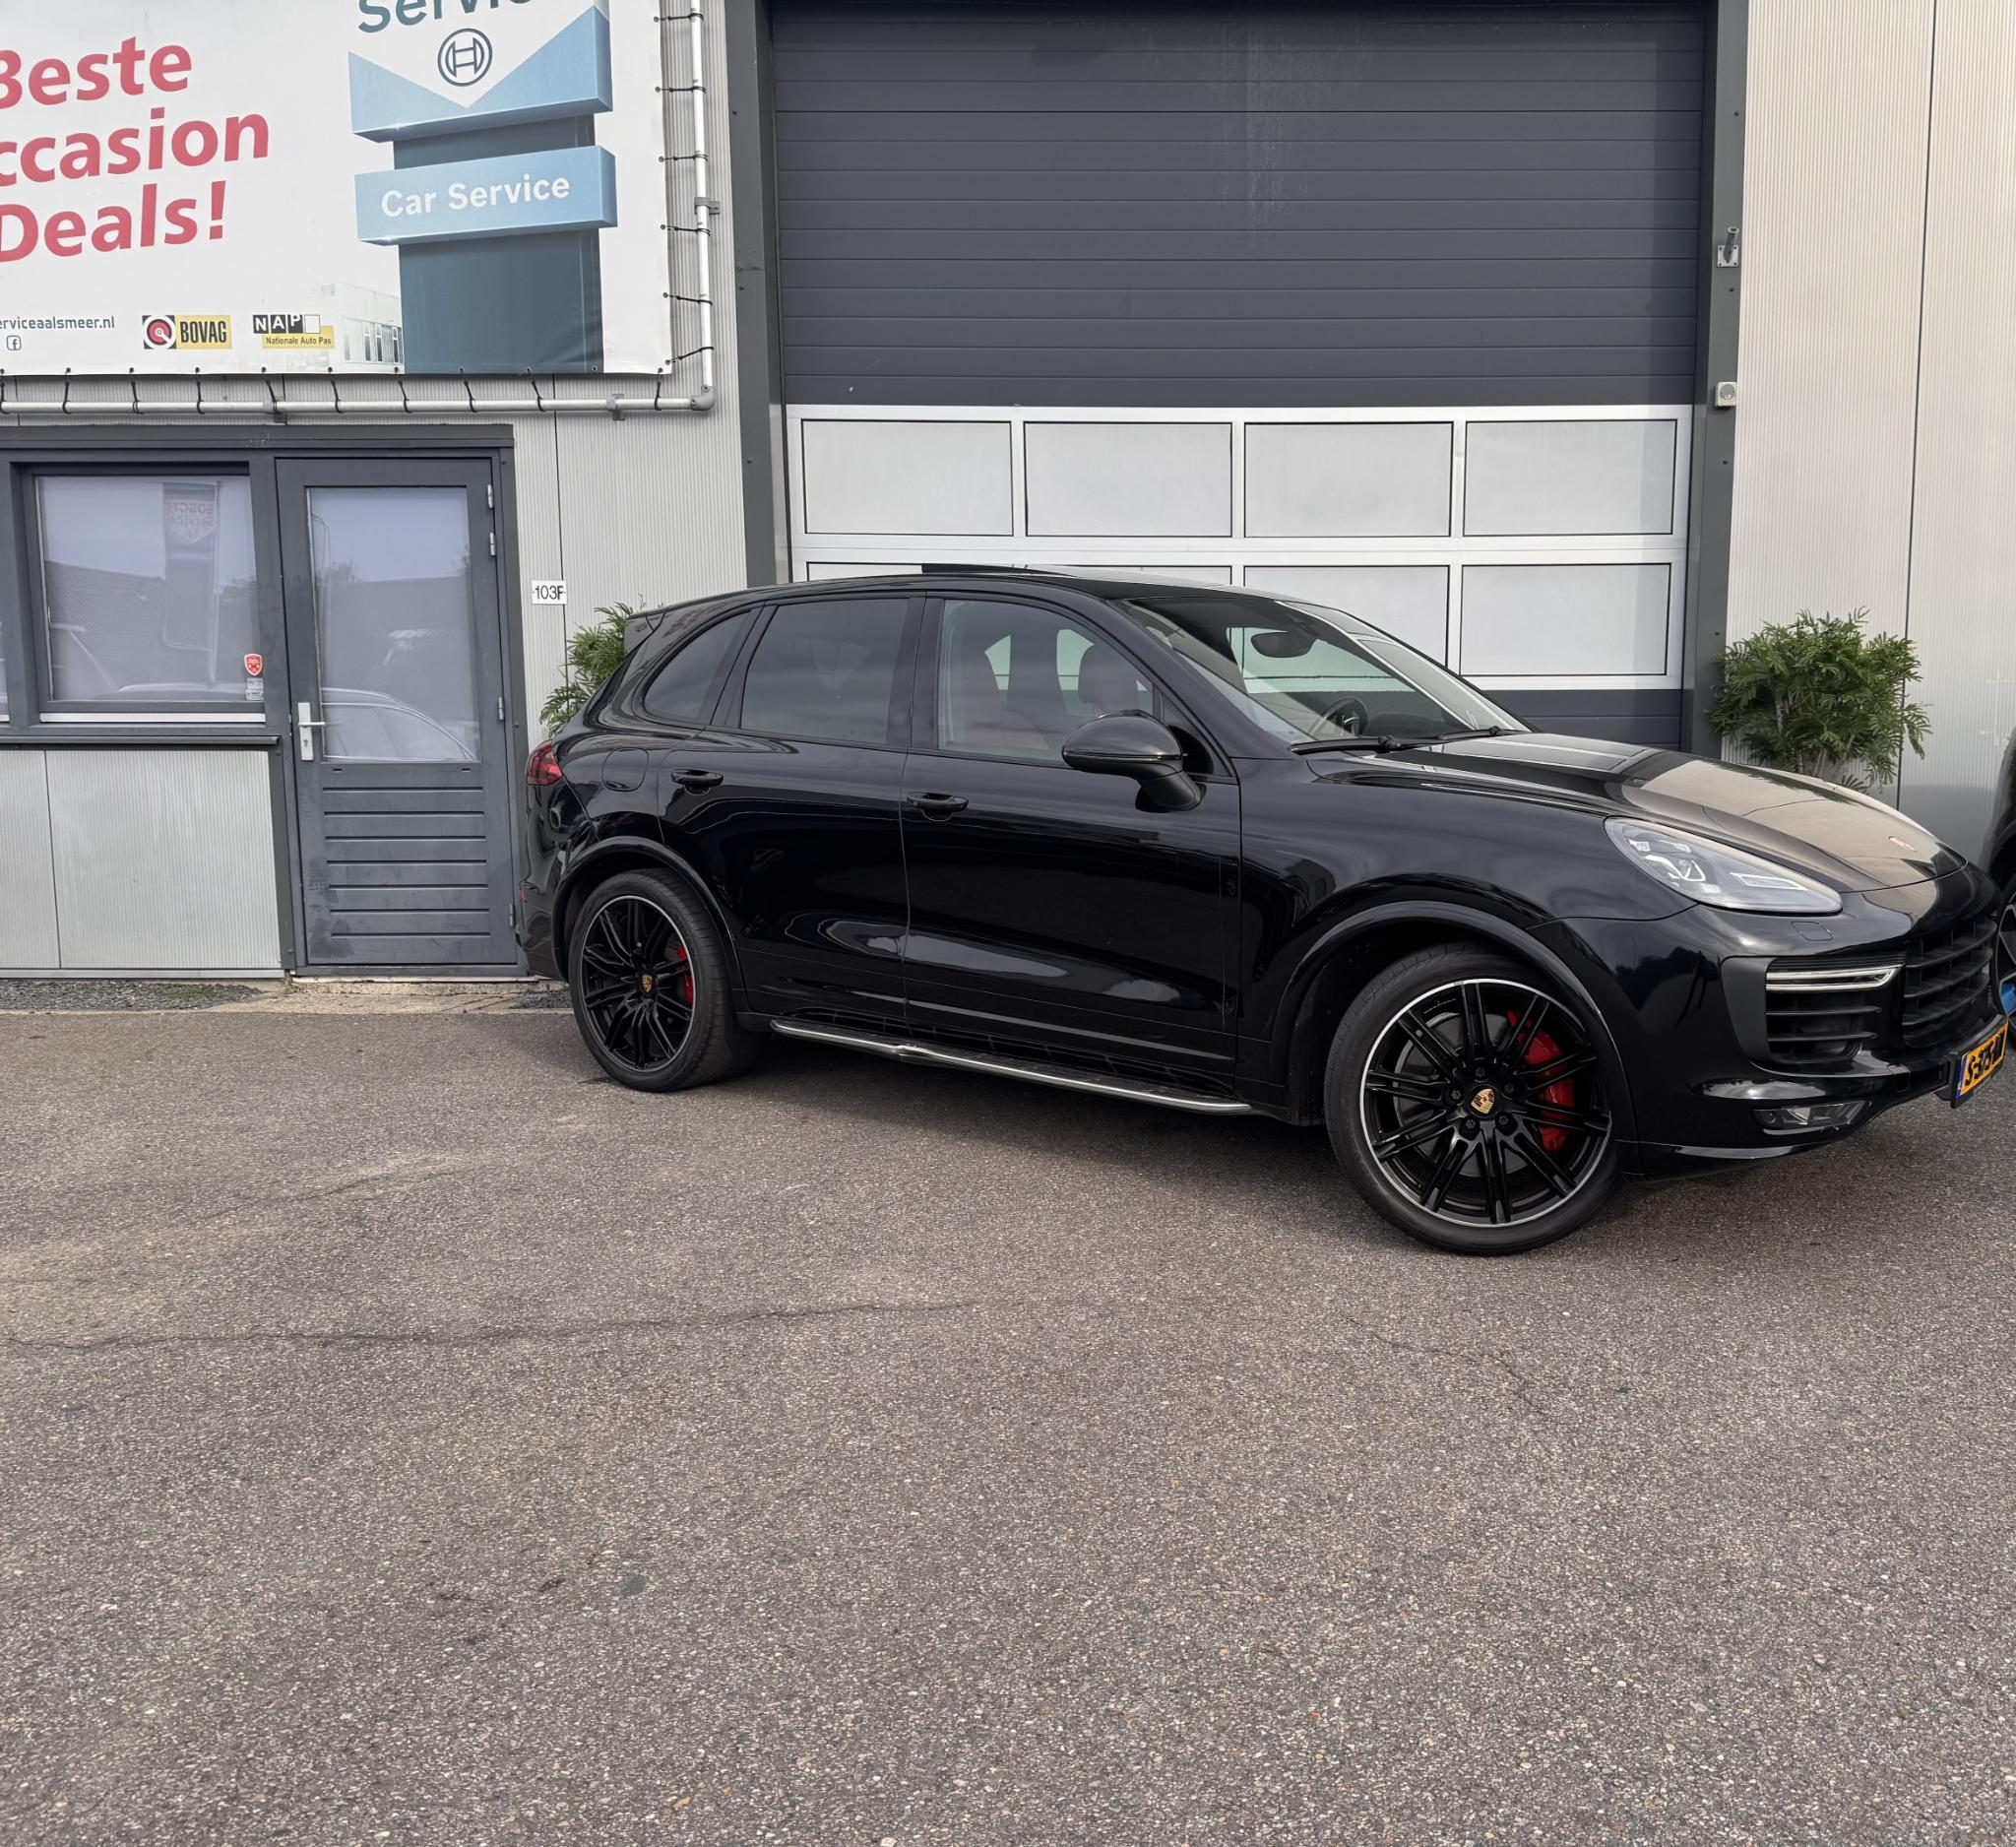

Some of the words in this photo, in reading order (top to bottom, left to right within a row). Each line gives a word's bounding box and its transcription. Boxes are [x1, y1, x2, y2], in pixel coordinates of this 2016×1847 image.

[381, 189, 437, 217] Car
[448, 173, 570, 210] Service
[0, 180, 225, 263] Deals!
[180, 320, 227, 344] BOVAG
[254, 314, 302, 333] NAP
[266, 336, 298, 345] Nationale
[300, 336, 316, 345] Auto
[318, 336, 332, 345] Pas
[535, 585, 564, 600] 103F
